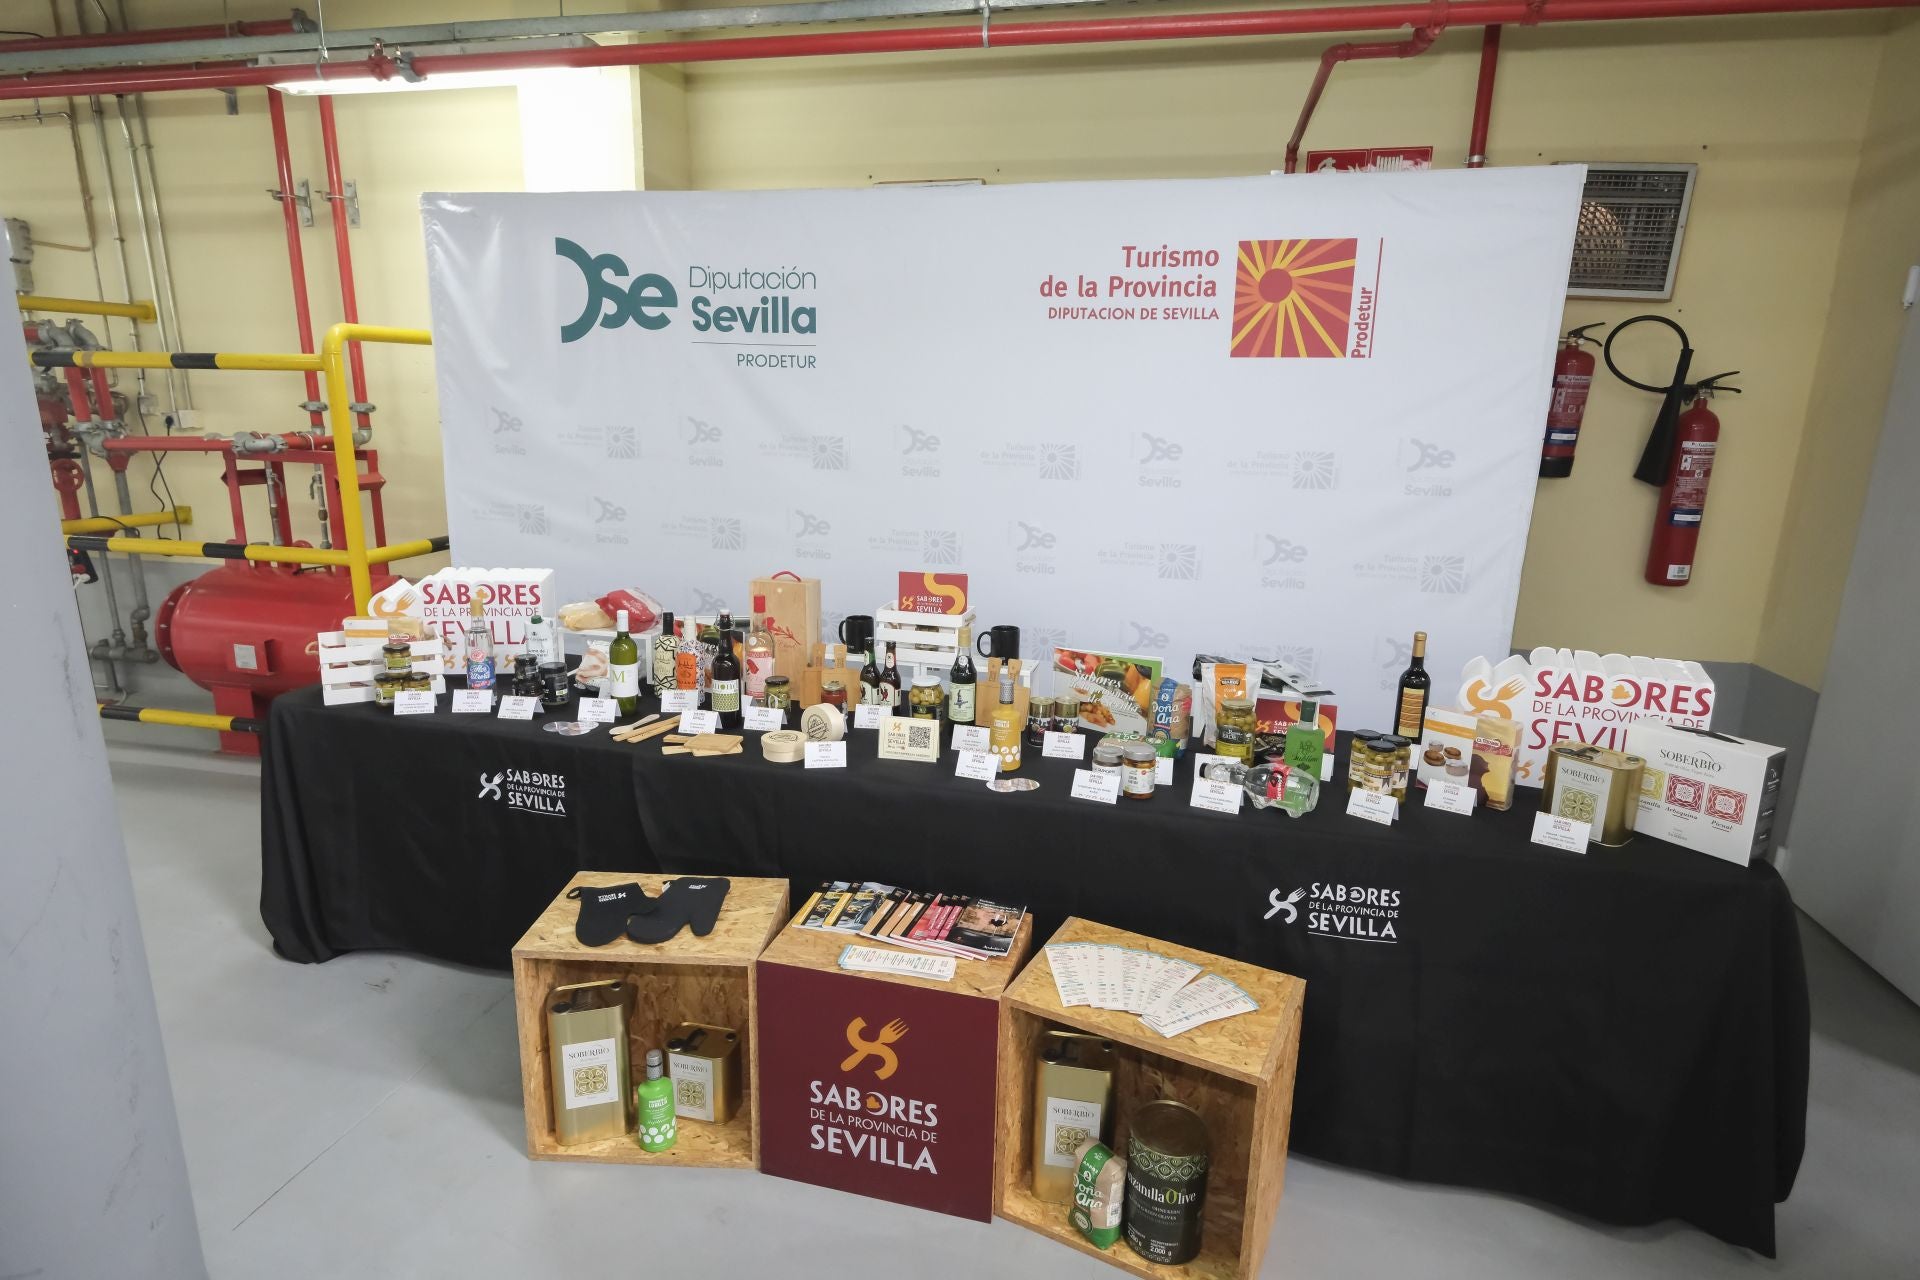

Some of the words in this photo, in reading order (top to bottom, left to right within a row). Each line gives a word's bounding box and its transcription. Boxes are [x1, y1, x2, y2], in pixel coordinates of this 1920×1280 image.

[1122, 246, 1219, 268] Turismo
[689, 265, 817, 295] Diputación
[1040, 274, 1067, 298] de
[1078, 274, 1097, 298] la
[1109, 273, 1217, 298] Provincia
[691, 296, 817, 334] Sevilla
[1048, 307, 1136, 320] DIPUTACION
[1141, 307, 1158, 320] DE
[1162, 307, 1219, 320] SEVILLA
[1351, 287, 1373, 359] Prodetur
[737, 353, 817, 369] PRODETUR
[422, 583, 541, 605] SABORES
[424, 607, 438, 617] DE
[442, 607, 456, 617] LA
[459, 607, 522, 617] PRVINCIA
[612, 671, 625, 683] M
[1535, 670, 1712, 717] SABORES
[1152, 701, 1179, 712] Doña
[1532, 701, 1552, 714] DE
[1557, 703, 1577, 718] LA
[1156, 712, 1180, 724] Ana
[1660, 749, 1722, 773] SOBERBIO
[506, 768, 565, 789] SABORES
[1561, 767, 1605, 783] SOBERBIO
[524, 786, 557, 797] PROVINCIA
[508, 792, 565, 813] SEVILLA
[1711, 820, 1734, 831] Picual
[1310, 883, 1400, 907] SABORES
[1322, 903, 1333, 912] LA
[1335, 904, 1385, 918] PROVINCIA
[1387, 910, 1399, 918] DE
[1308, 912, 1397, 938] SEVILLA
[568, 1047, 610, 1060] SOBERBIO
[673, 1061, 708, 1073] SOBERBIO
[810, 1080, 938, 1128] SABORES
[1053, 1106, 1095, 1119] SOBERBIO
[810, 1107, 826, 1121] DE
[829, 1112, 844, 1125] LA
[848, 1115, 918, 1140] PROVINCIA
[921, 1130, 937, 1144] DE
[810, 1124, 938, 1175] SEVILLA
[1076, 1192, 1103, 1210] Ana
